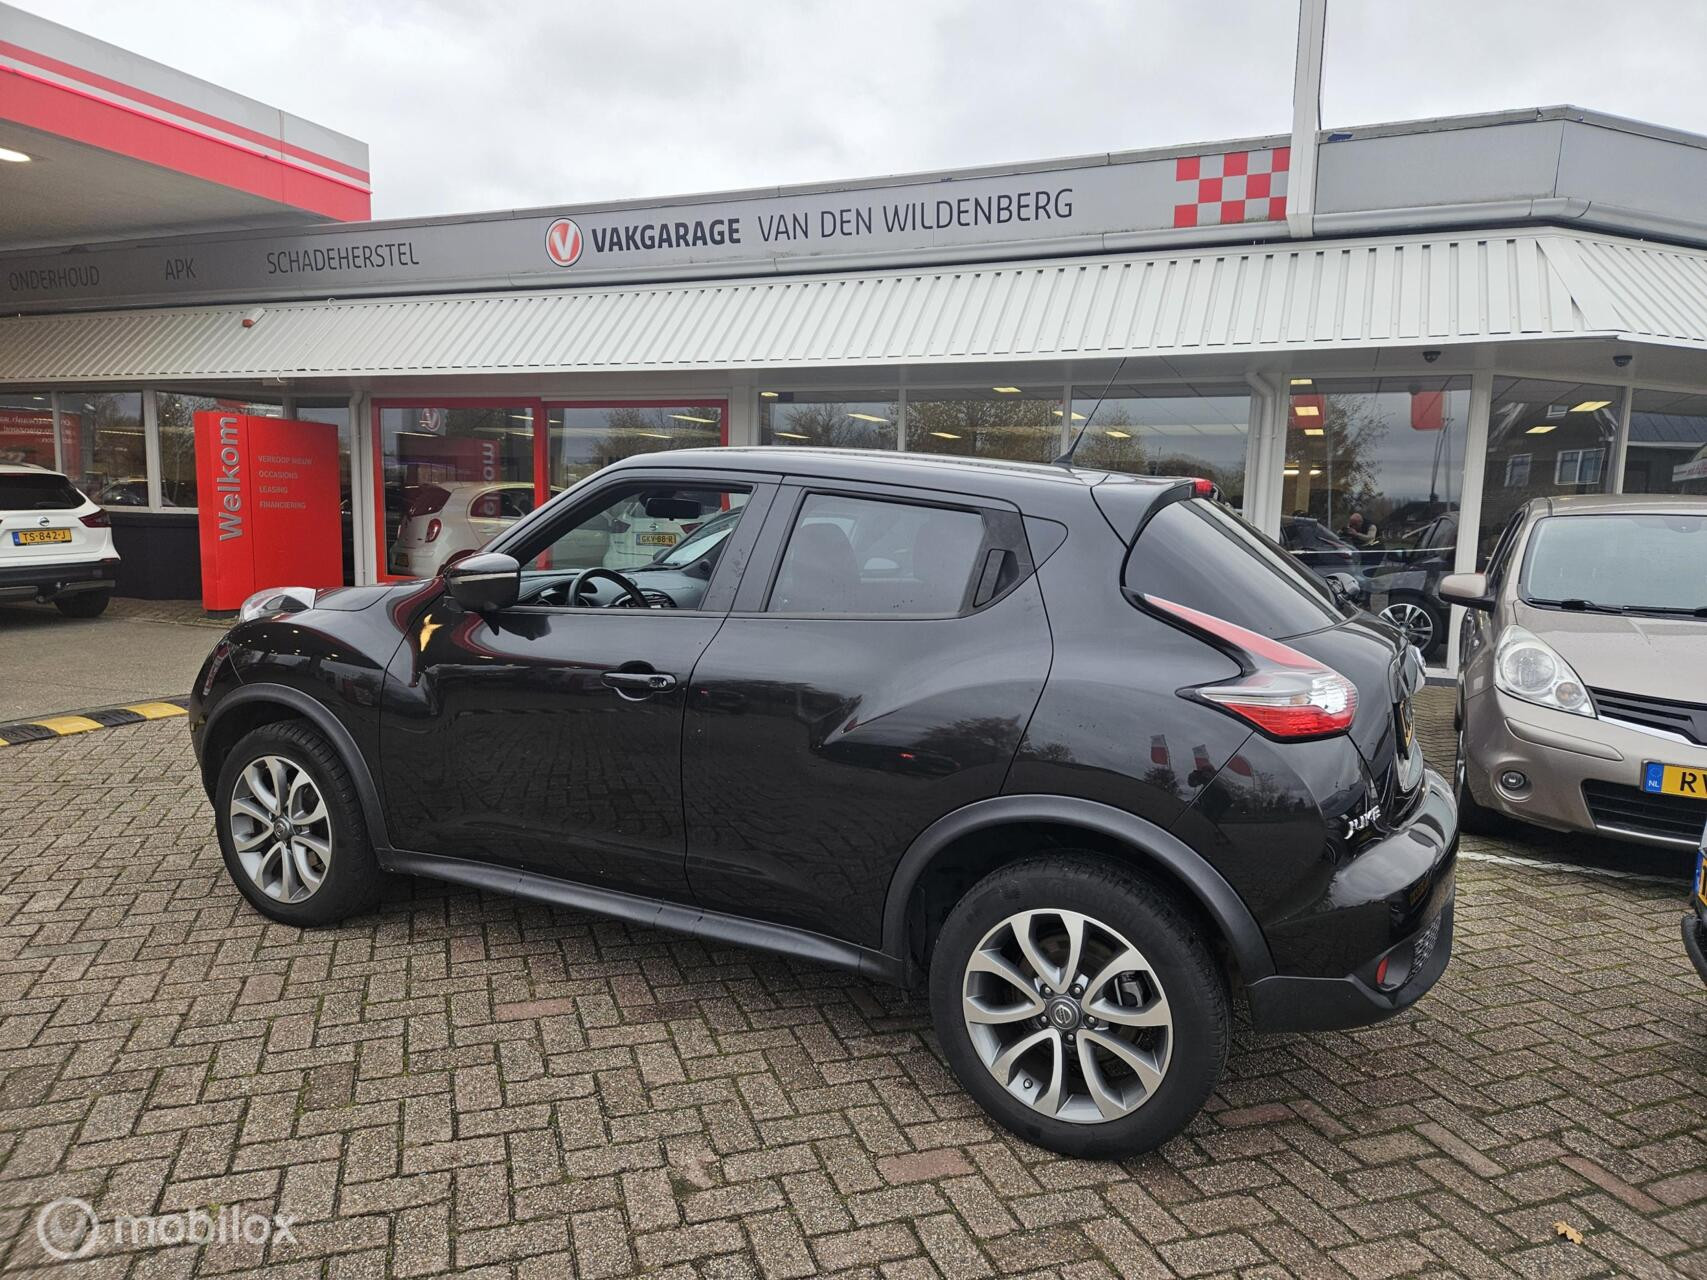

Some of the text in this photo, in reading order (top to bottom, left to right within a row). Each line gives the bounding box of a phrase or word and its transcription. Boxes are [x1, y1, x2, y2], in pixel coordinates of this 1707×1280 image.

[591, 217, 742, 253] VAKGARAGE
[757, 211, 809, 242] VAN
[820, 206, 873, 238] DEN
[881, 188, 1075, 233] WILDENBERG
[165, 257, 197, 281] APK
[266, 241, 421, 275] SCHADEHERSTEL
[8, 265, 100, 291] ONDERHOUD
[217, 416, 243, 542] Welkom
[1648, 779, 1660, 788] NL
[1679, 771, 1707, 795] R
